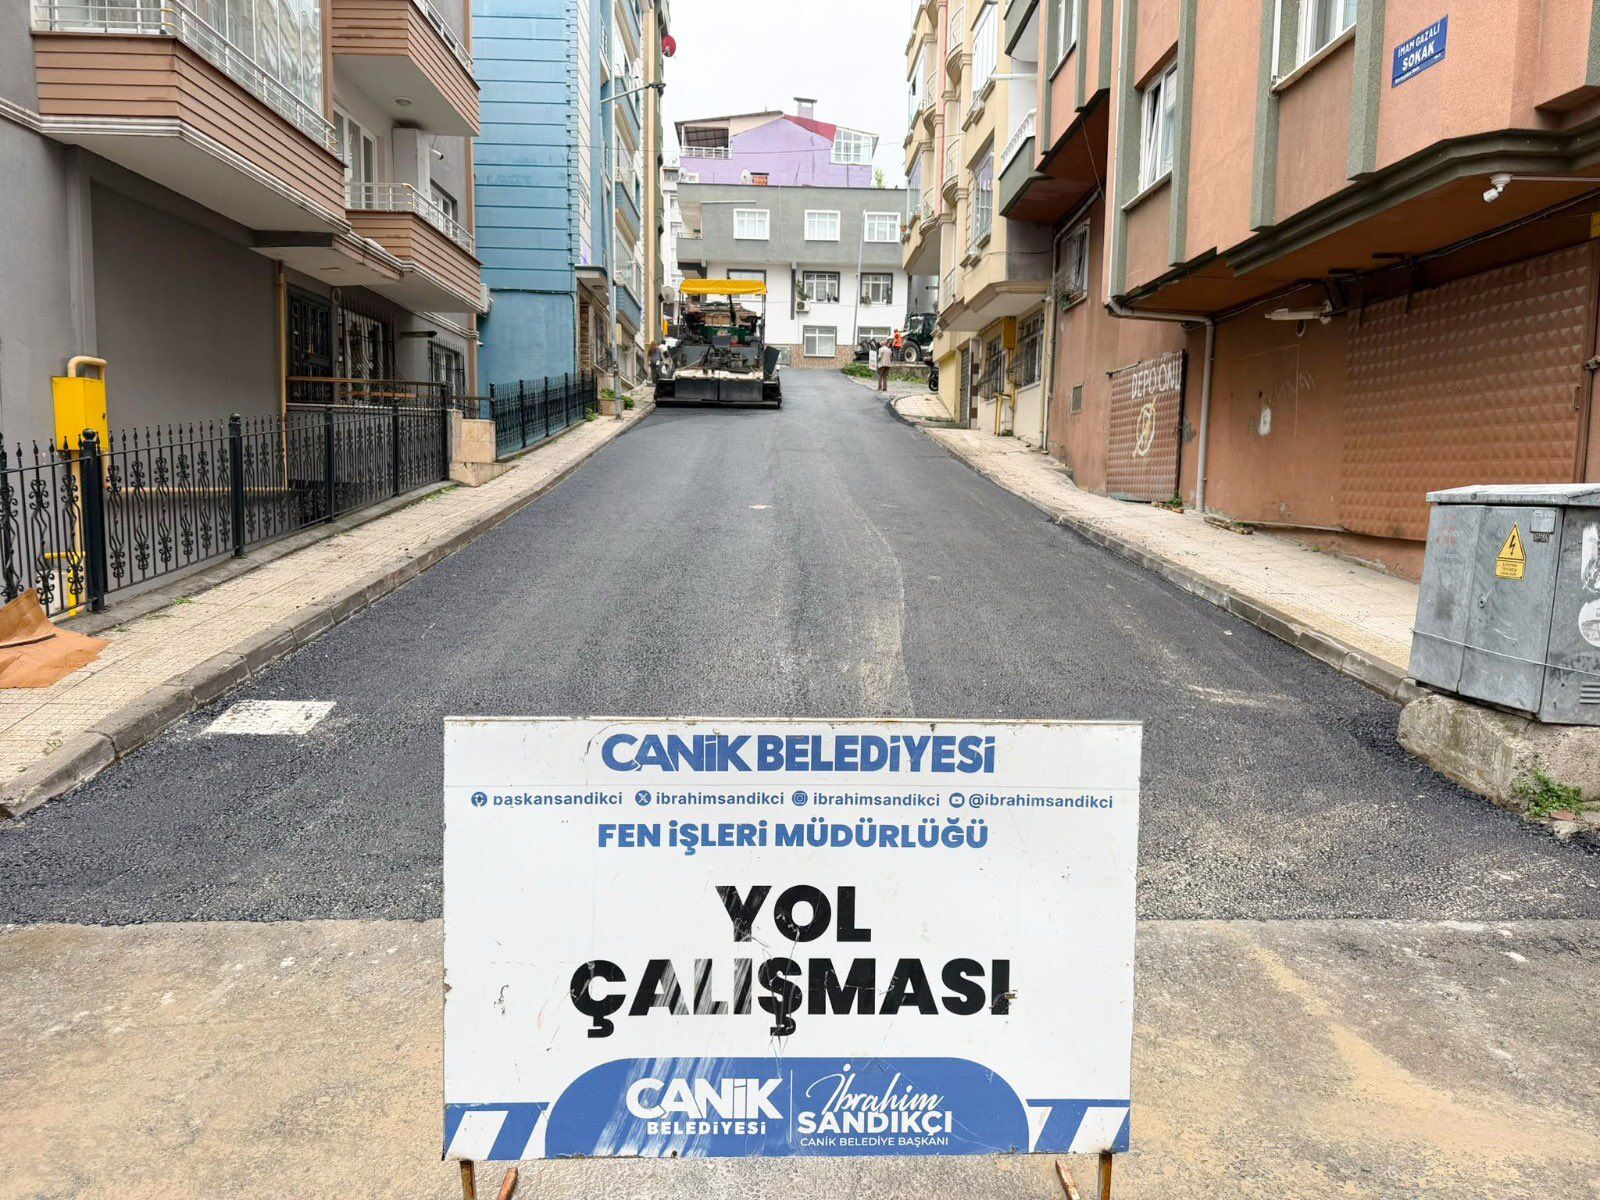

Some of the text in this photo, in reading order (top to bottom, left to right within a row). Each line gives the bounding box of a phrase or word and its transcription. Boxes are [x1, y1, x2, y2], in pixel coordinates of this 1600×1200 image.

[1402, 40, 1435, 71] SOKAK
[602, 734, 995, 774] CANİK BELEDİYESİ
[656, 792, 785, 806] ibrahimsandikci
[813, 792, 940, 807] ibrahimsandikci
[968, 793, 1113, 810] @ibrahimsandikci
[599, 817, 989, 857] FEN İŞLERİ MÜDÜRLÜĞÜ
[715, 884, 872, 943] YOL
[569, 957, 1011, 1039] ÇALIŞMASI
[625, 1077, 784, 1120] CANİK
[806, 1063, 944, 1114] İbrahim
[646, 1121, 767, 1136] BELEDİYESİ
[797, 1109, 953, 1136] SANDIKÇI
[800, 1135, 949, 1148] CANİK BELEDİYE BAŞKANI
